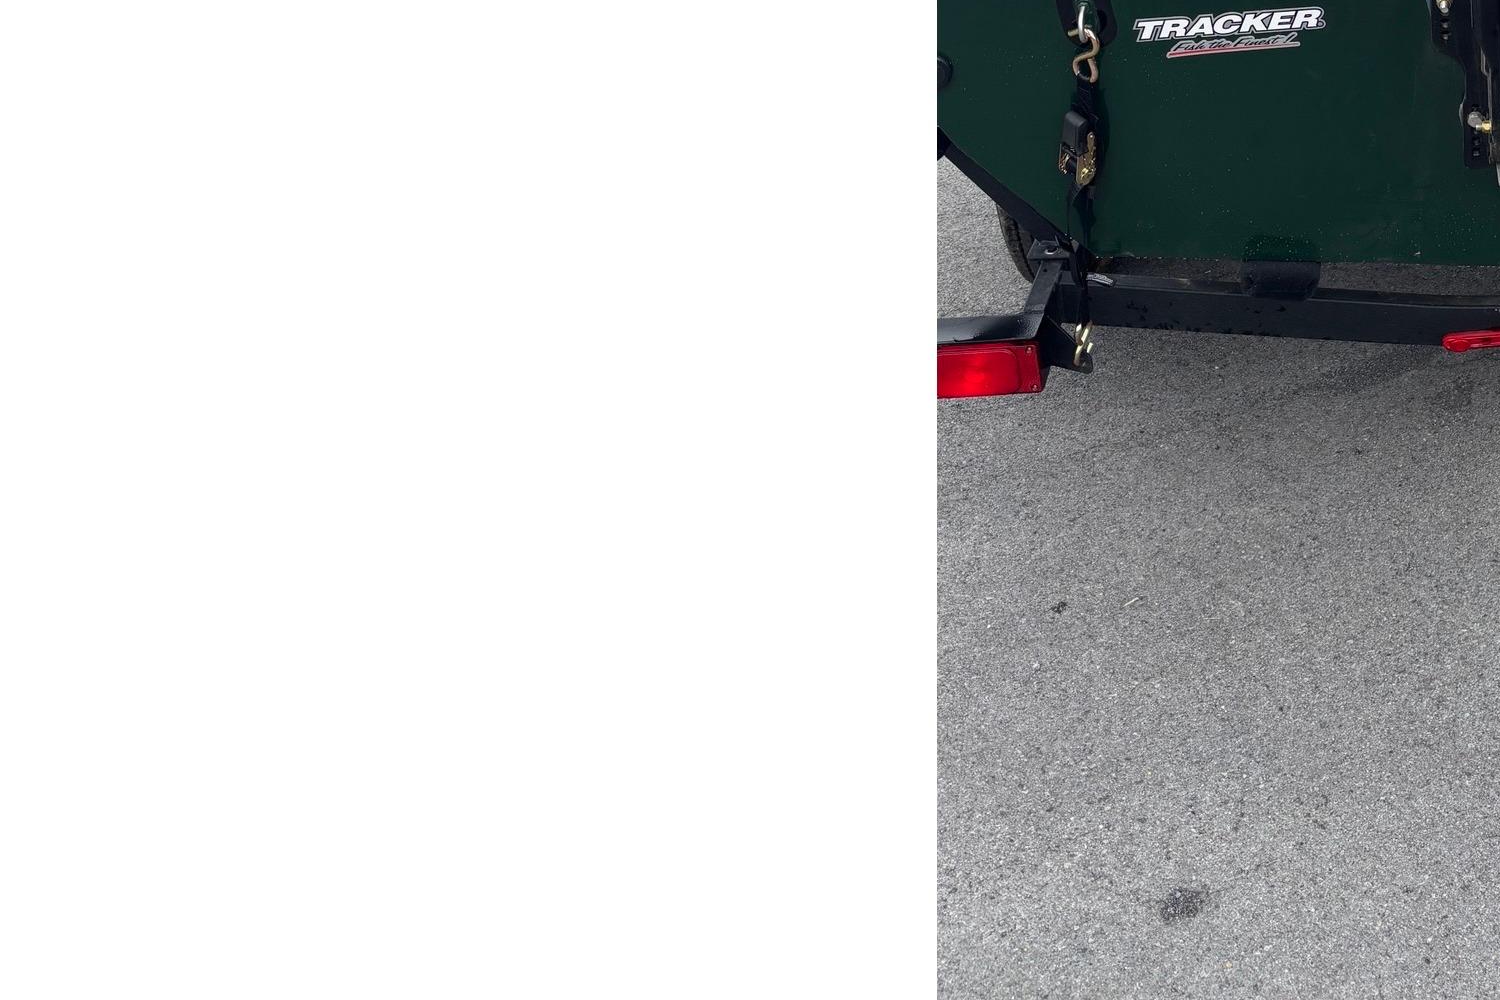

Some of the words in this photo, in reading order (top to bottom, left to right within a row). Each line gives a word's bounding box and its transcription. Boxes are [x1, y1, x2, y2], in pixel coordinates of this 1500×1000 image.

[1136, 8, 1323, 41] TRACKER
[1172, 41, 1205, 52] Fish
[1206, 39, 1231, 49] the
